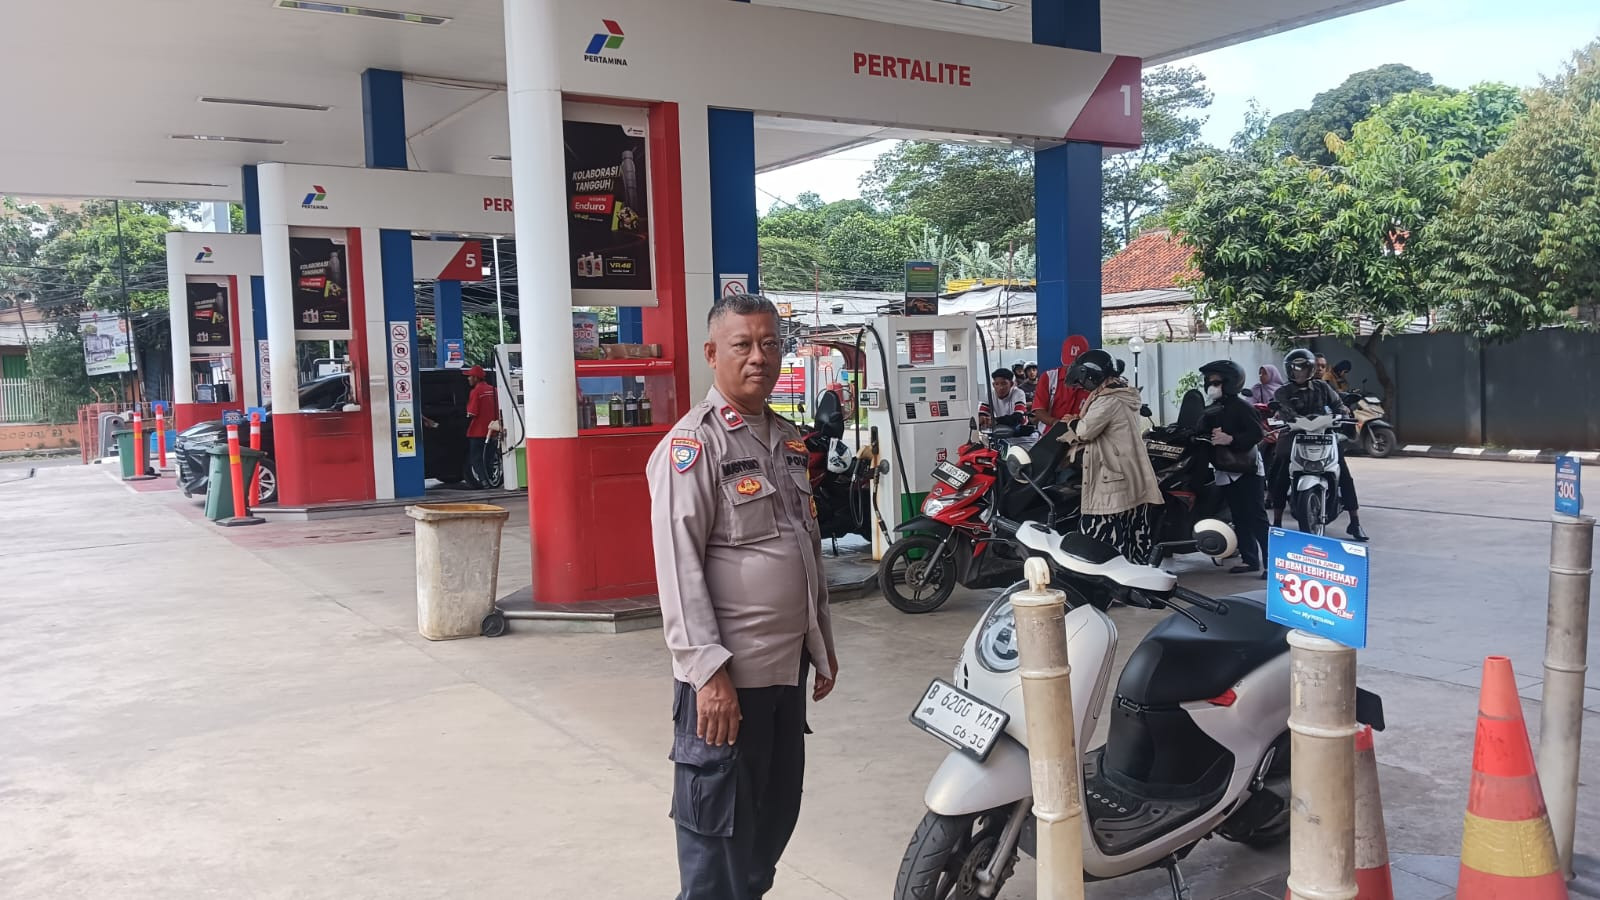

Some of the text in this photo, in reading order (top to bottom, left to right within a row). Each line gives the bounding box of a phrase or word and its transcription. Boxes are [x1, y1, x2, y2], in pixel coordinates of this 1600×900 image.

[583, 54, 628, 66] PERTAMINA
[853, 52, 971, 87] PERTALITE
[1119, 84, 1131, 117] 1
[572, 165, 619, 180] KOLABORASI
[575, 179, 612, 192] TANGGUH
[483, 197, 513, 212] PER
[575, 201, 606, 211] Enduro
[465, 253, 477, 268] 5
[1285, 559, 1303, 573] BBM
[1303, 563, 1326, 579] LEBIH
[1326, 570, 1358, 587] HEMAT
[1281, 573, 1347, 614] 300
[928, 684, 941, 700] B
[975, 708, 1000, 732] YAA
